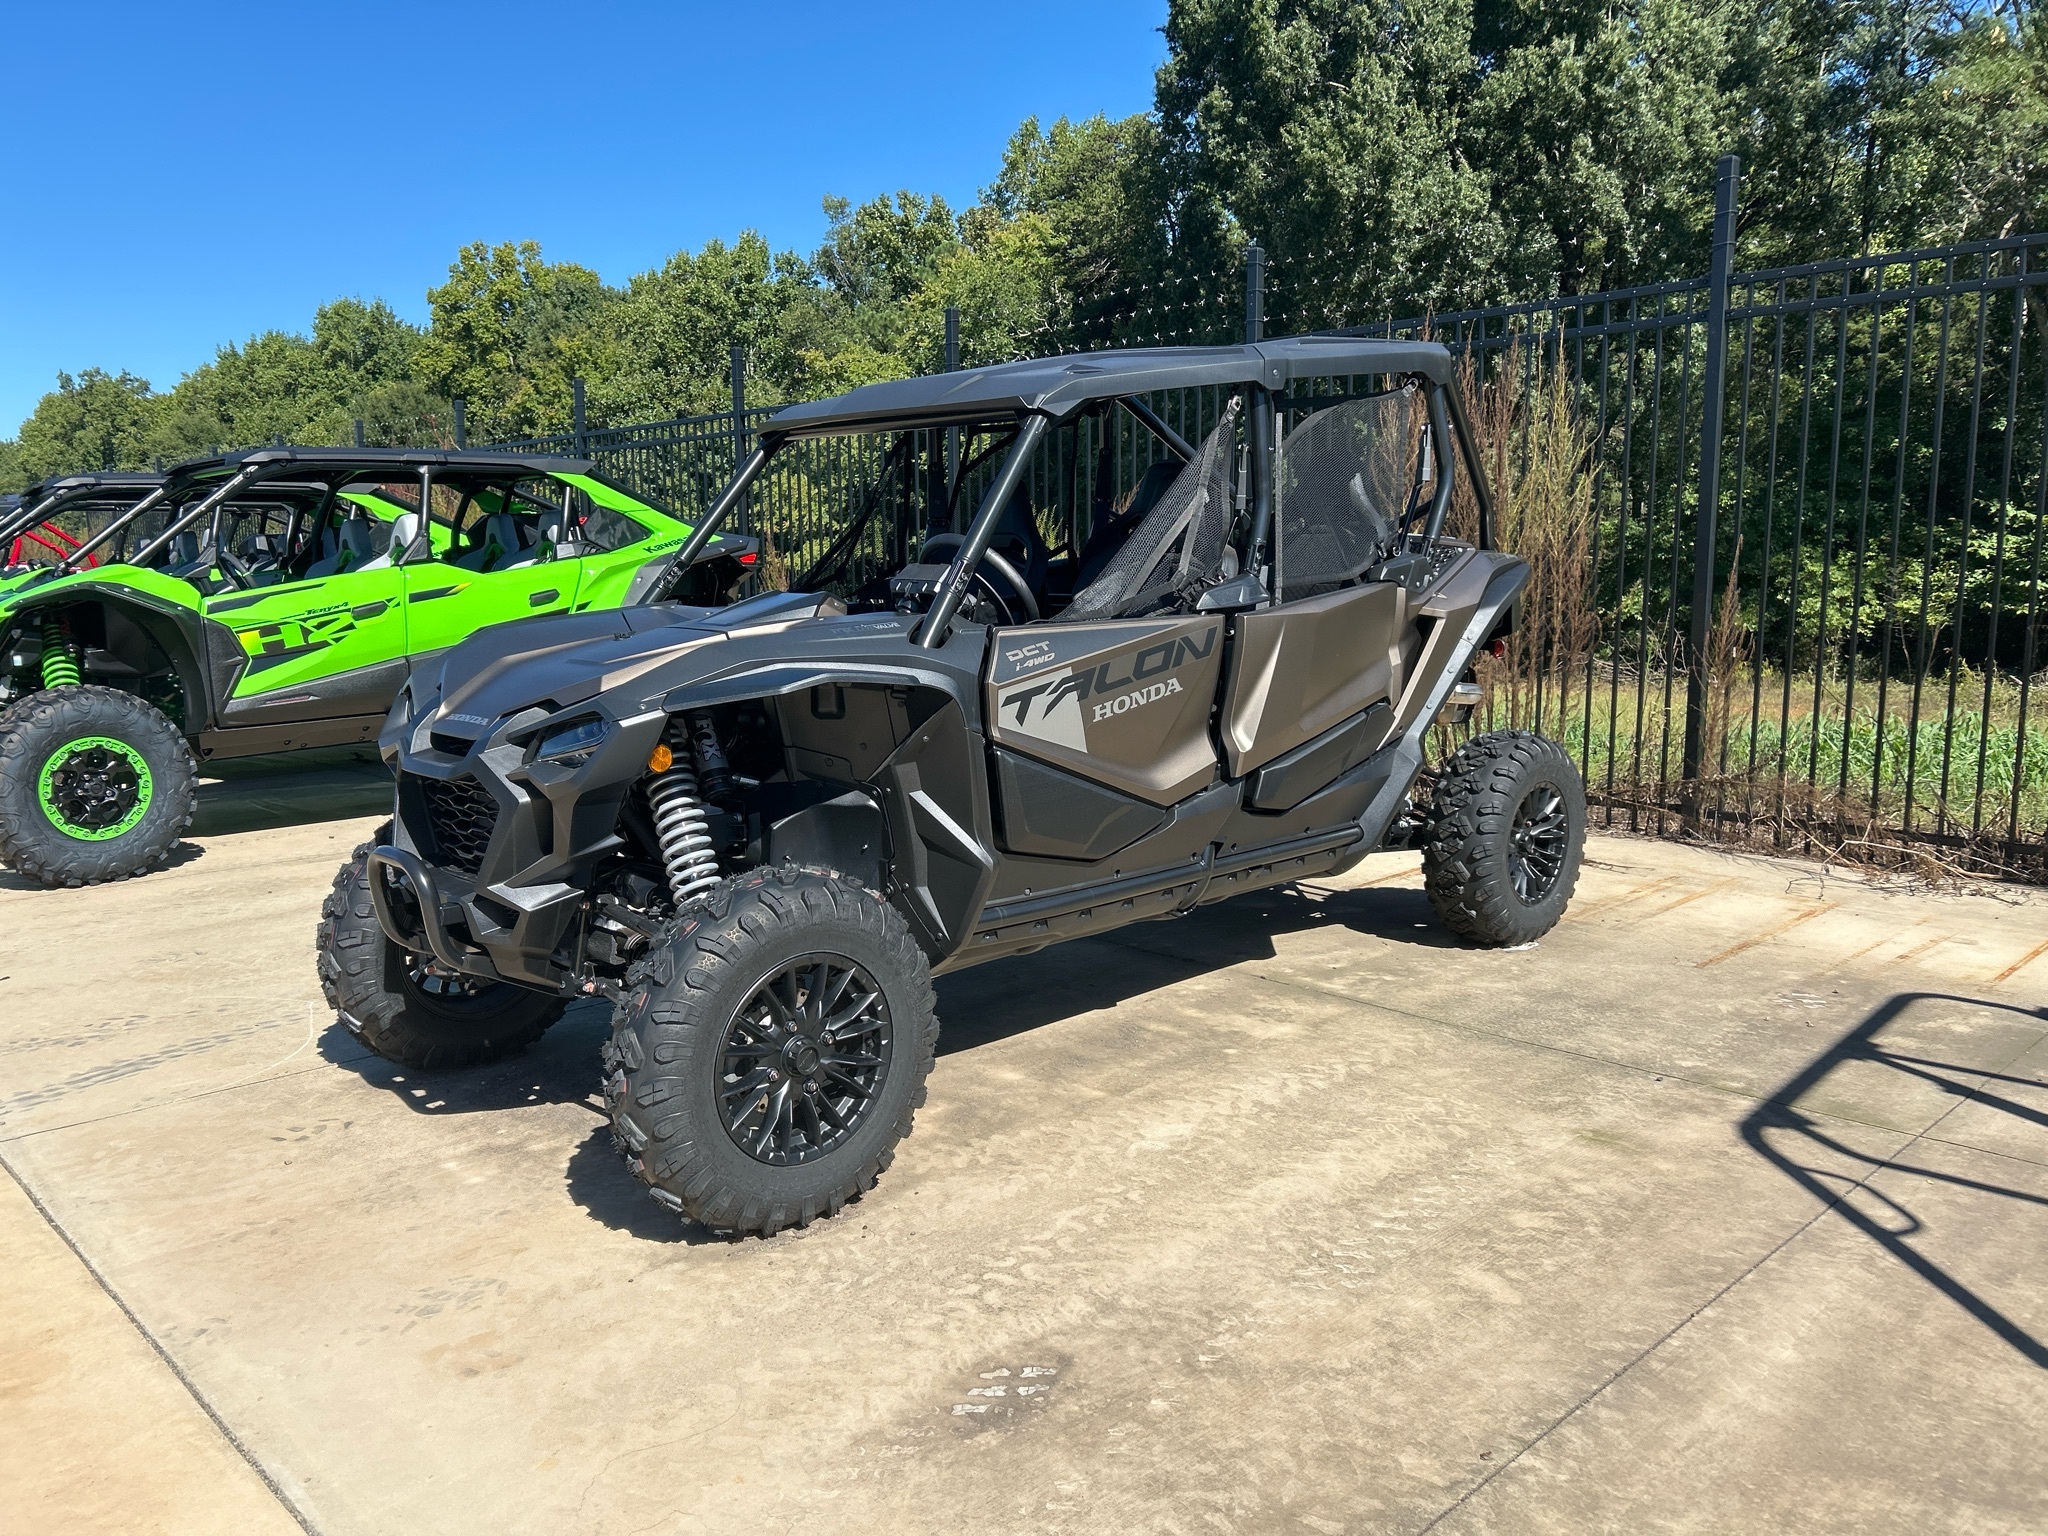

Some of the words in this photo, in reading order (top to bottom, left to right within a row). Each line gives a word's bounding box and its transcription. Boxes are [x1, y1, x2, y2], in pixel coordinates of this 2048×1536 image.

[642, 534, 690, 553] Kawas
[1005, 640, 1050, 662] DCT
[1000, 625, 1218, 727] TALON
[1093, 677, 1184, 722] HONDA
[445, 712, 490, 726] HONDA
